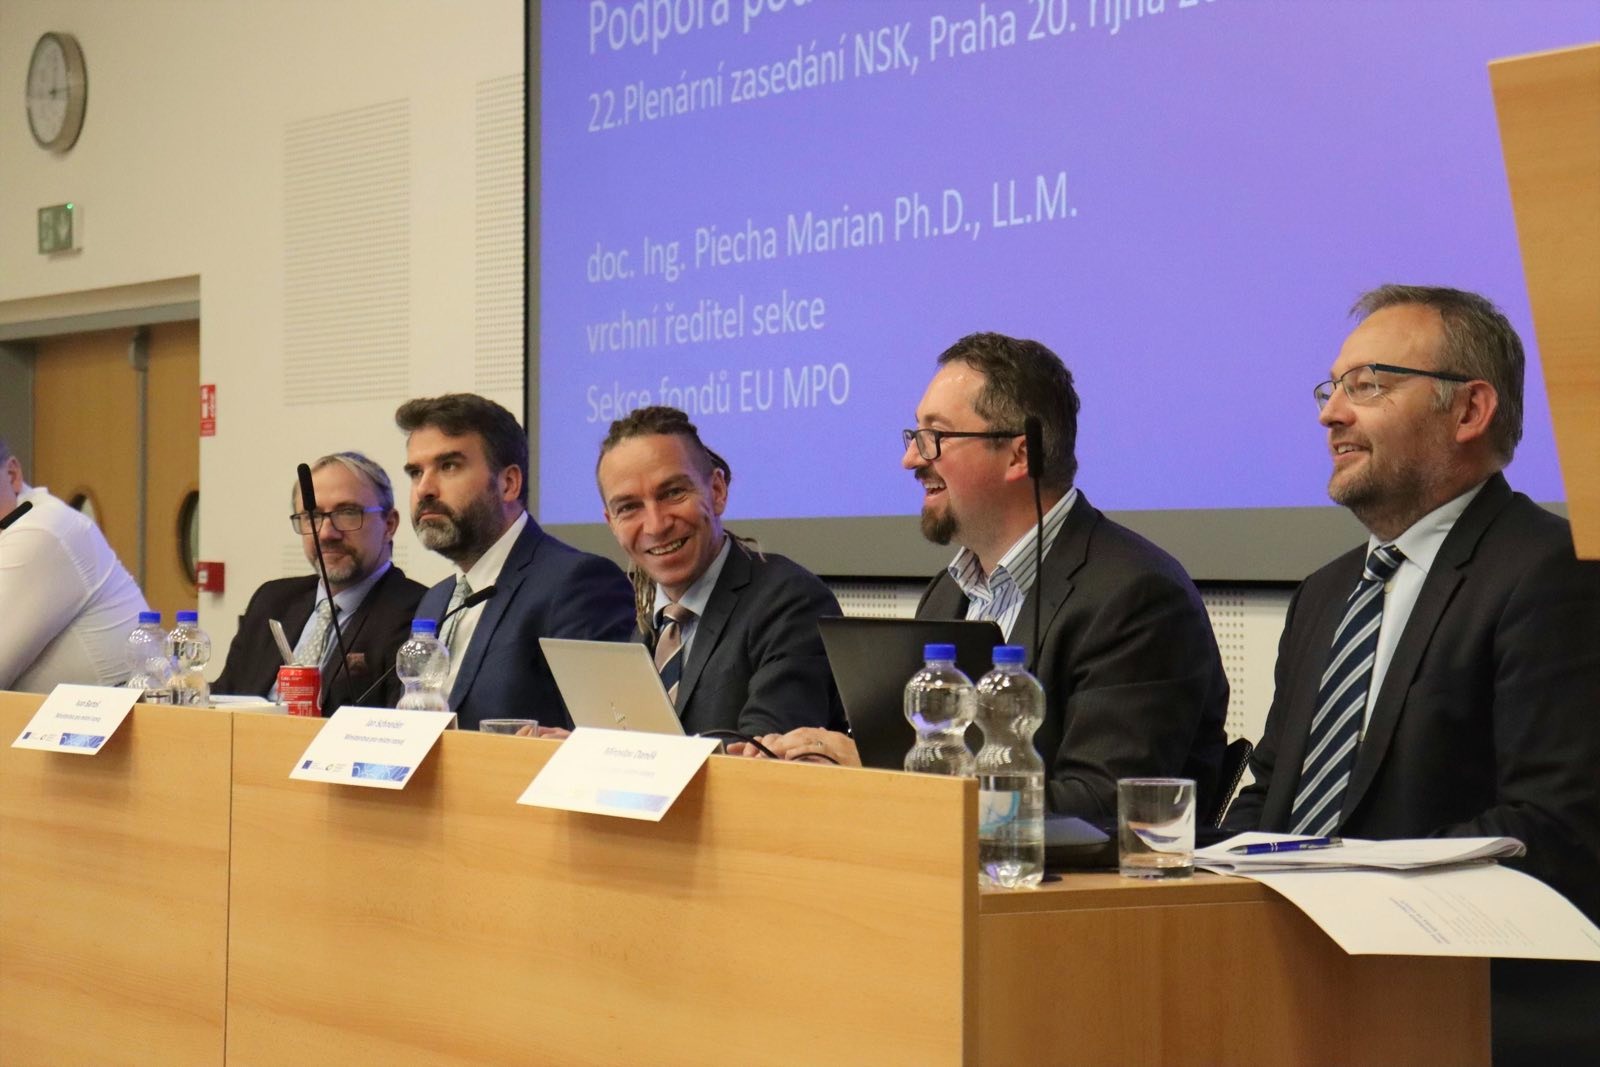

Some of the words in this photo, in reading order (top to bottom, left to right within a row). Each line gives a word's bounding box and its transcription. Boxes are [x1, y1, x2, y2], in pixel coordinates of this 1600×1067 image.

[588, 61, 725, 132] 22.Plenární
[731, 33, 845, 103] zasedání
[854, 22, 920, 77] NSK,
[929, 2, 1016, 62] Praha
[1027, 0, 1077, 42] 20.
[587, 243, 634, 283] doc.
[644, 236, 686, 284] Ing.
[696, 218, 777, 269] Piecha
[787, 204, 884, 257] Marian
[895, 188, 980, 242] Ph.D.,
[992, 171, 1077, 228] LL.M.
[587, 304, 658, 354] vrchní
[665, 294, 744, 345] ředitel
[752, 289, 825, 336] sekce
[658, 369, 731, 416] fondů
[740, 369, 773, 412] EU
[783, 362, 850, 410] MPO
